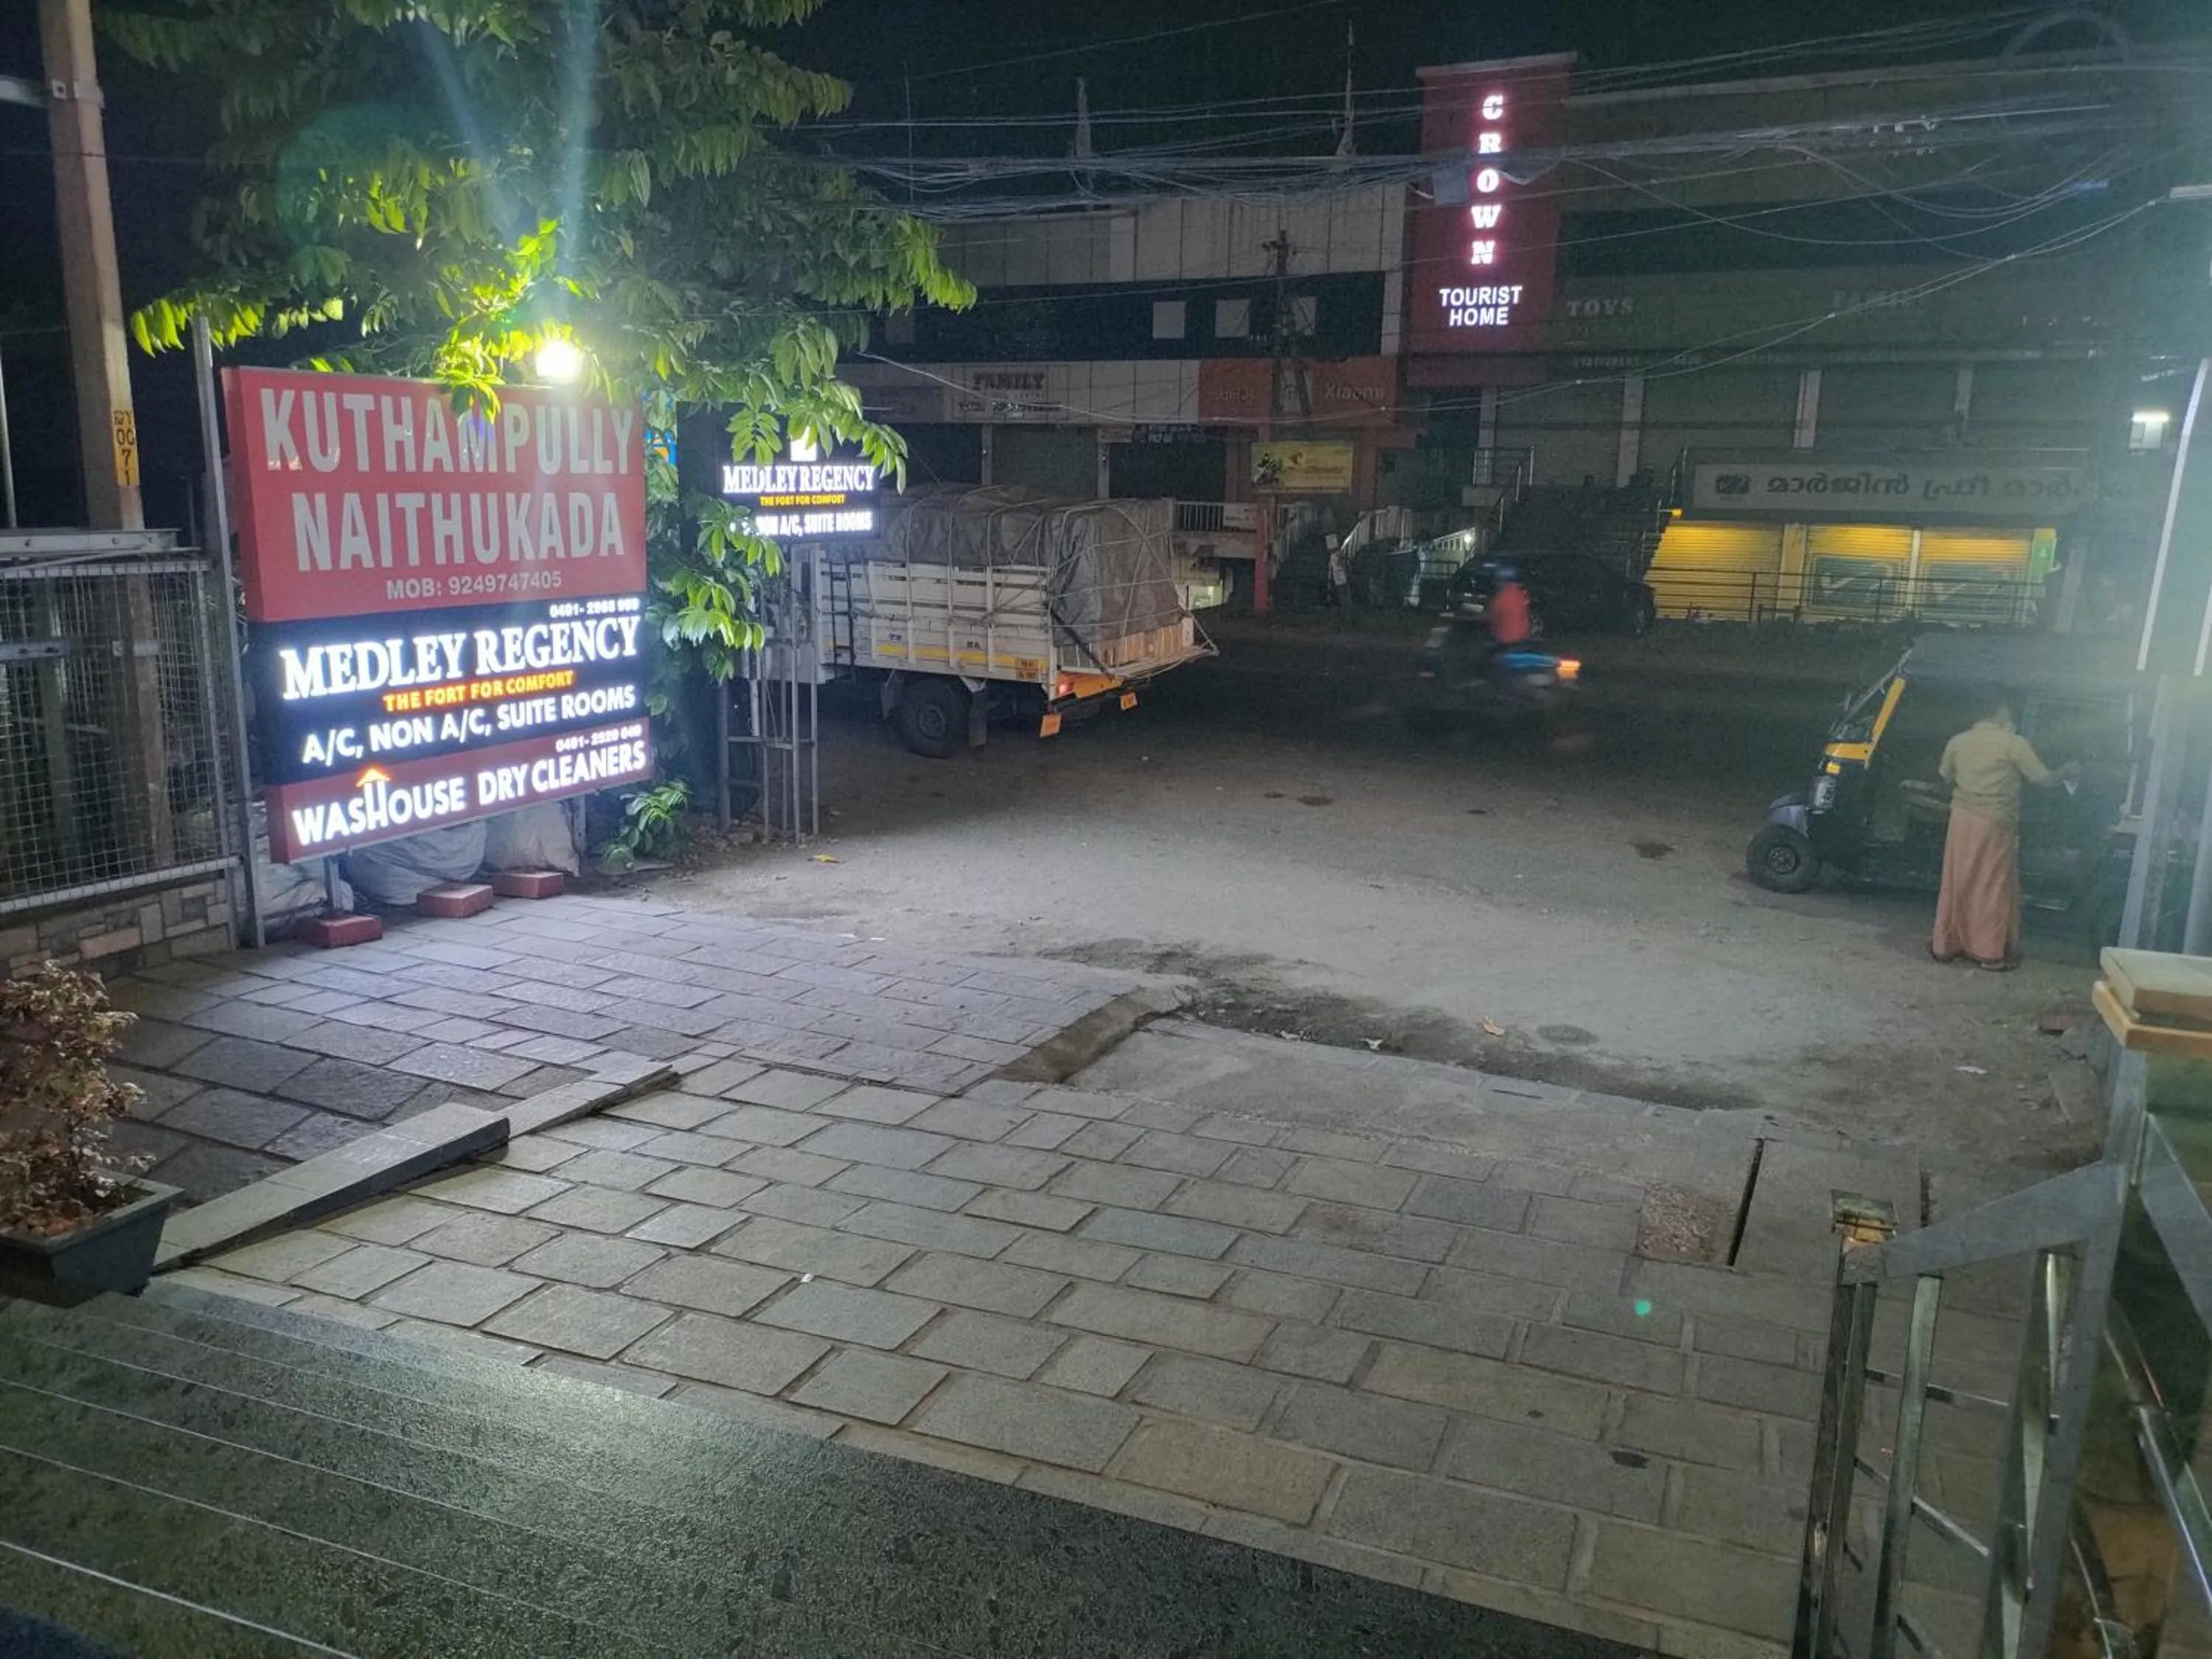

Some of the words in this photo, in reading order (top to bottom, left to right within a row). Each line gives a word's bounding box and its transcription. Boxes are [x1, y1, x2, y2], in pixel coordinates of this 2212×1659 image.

[1470, 95, 1505, 265] CROWN
[1439, 285, 1523, 307] TOURIST
[1449, 307, 1509, 327] HOME
[1567, 296, 1634, 316] TOYS
[260, 388, 636, 476] KUTHAMPULLY
[723, 465, 798, 493] MEDLEY
[798, 465, 875, 492] REGENCY
[291, 492, 625, 572] NAITHUKADA
[386, 580, 442, 600] MOB:
[448, 571, 563, 596] 9249747405
[280, 632, 468, 700] MEDLEY
[474, 616, 641, 676] REGENCY
[383, 689, 421, 712] THE
[424, 685, 466, 707] FORT
[470, 680, 504, 700] FOR
[506, 670, 574, 695] COMFORT
[302, 729, 364, 767] A/C,
[369, 715, 434, 754] NON
[440, 709, 492, 743] A/C,
[496, 697, 557, 730] SUITE
[560, 685, 636, 717] ROOMS
[293, 778, 466, 846] WASHOUSE
[478, 766, 530, 807] DRY
[531, 740, 647, 793] CLEANERS
